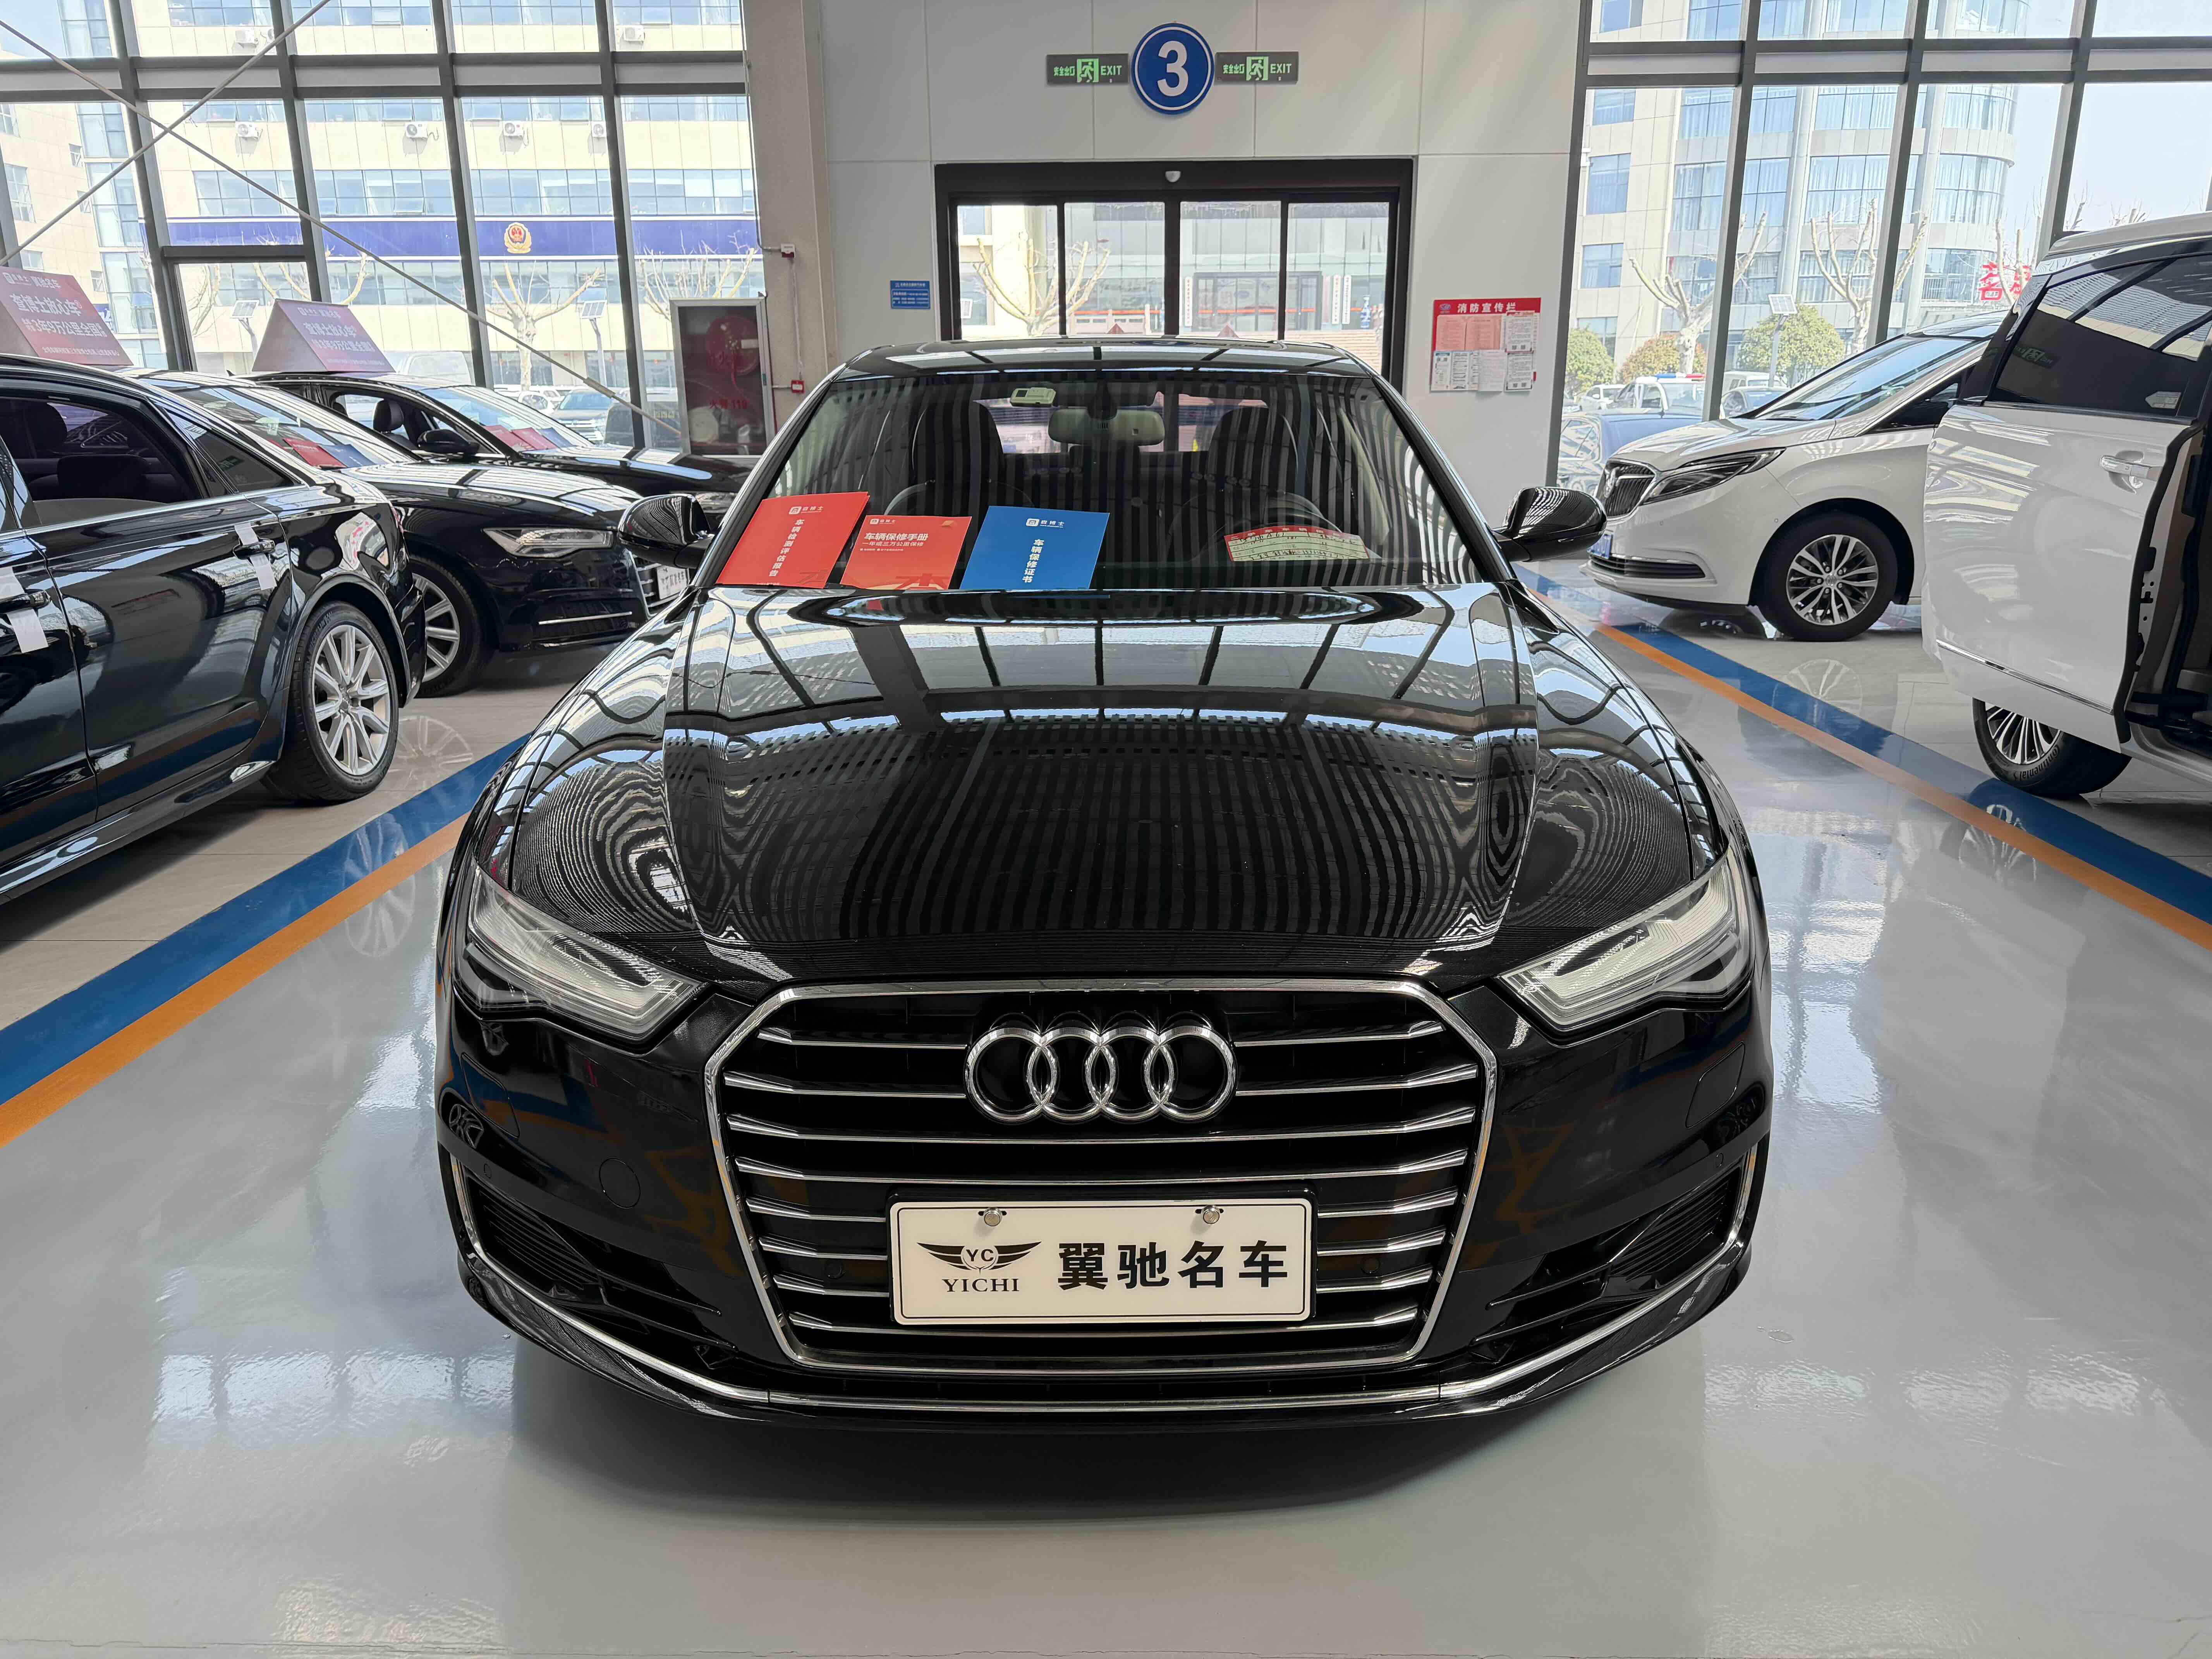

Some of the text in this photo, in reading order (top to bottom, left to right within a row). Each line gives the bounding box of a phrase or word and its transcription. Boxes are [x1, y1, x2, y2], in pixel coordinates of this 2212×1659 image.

[1101, 65, 1122, 76] EXIT
[1157, 40, 1189, 96] 3
[1270, 64, 1291, 74] EXIT
[1458, 302, 1516, 313] 消防宣传栏
[864, 533, 929, 541] 车辆保修手册
[769, 519, 805, 577] 车辆检测评估报告
[1022, 539, 1044, 583] 车辆保修证书
[2019, 744, 2060, 781] Continental
[966, 1249, 994, 1262] YC
[1057, 1240, 1288, 1291] 翼驰名车
[941, 1279, 1020, 1292] YICHI
